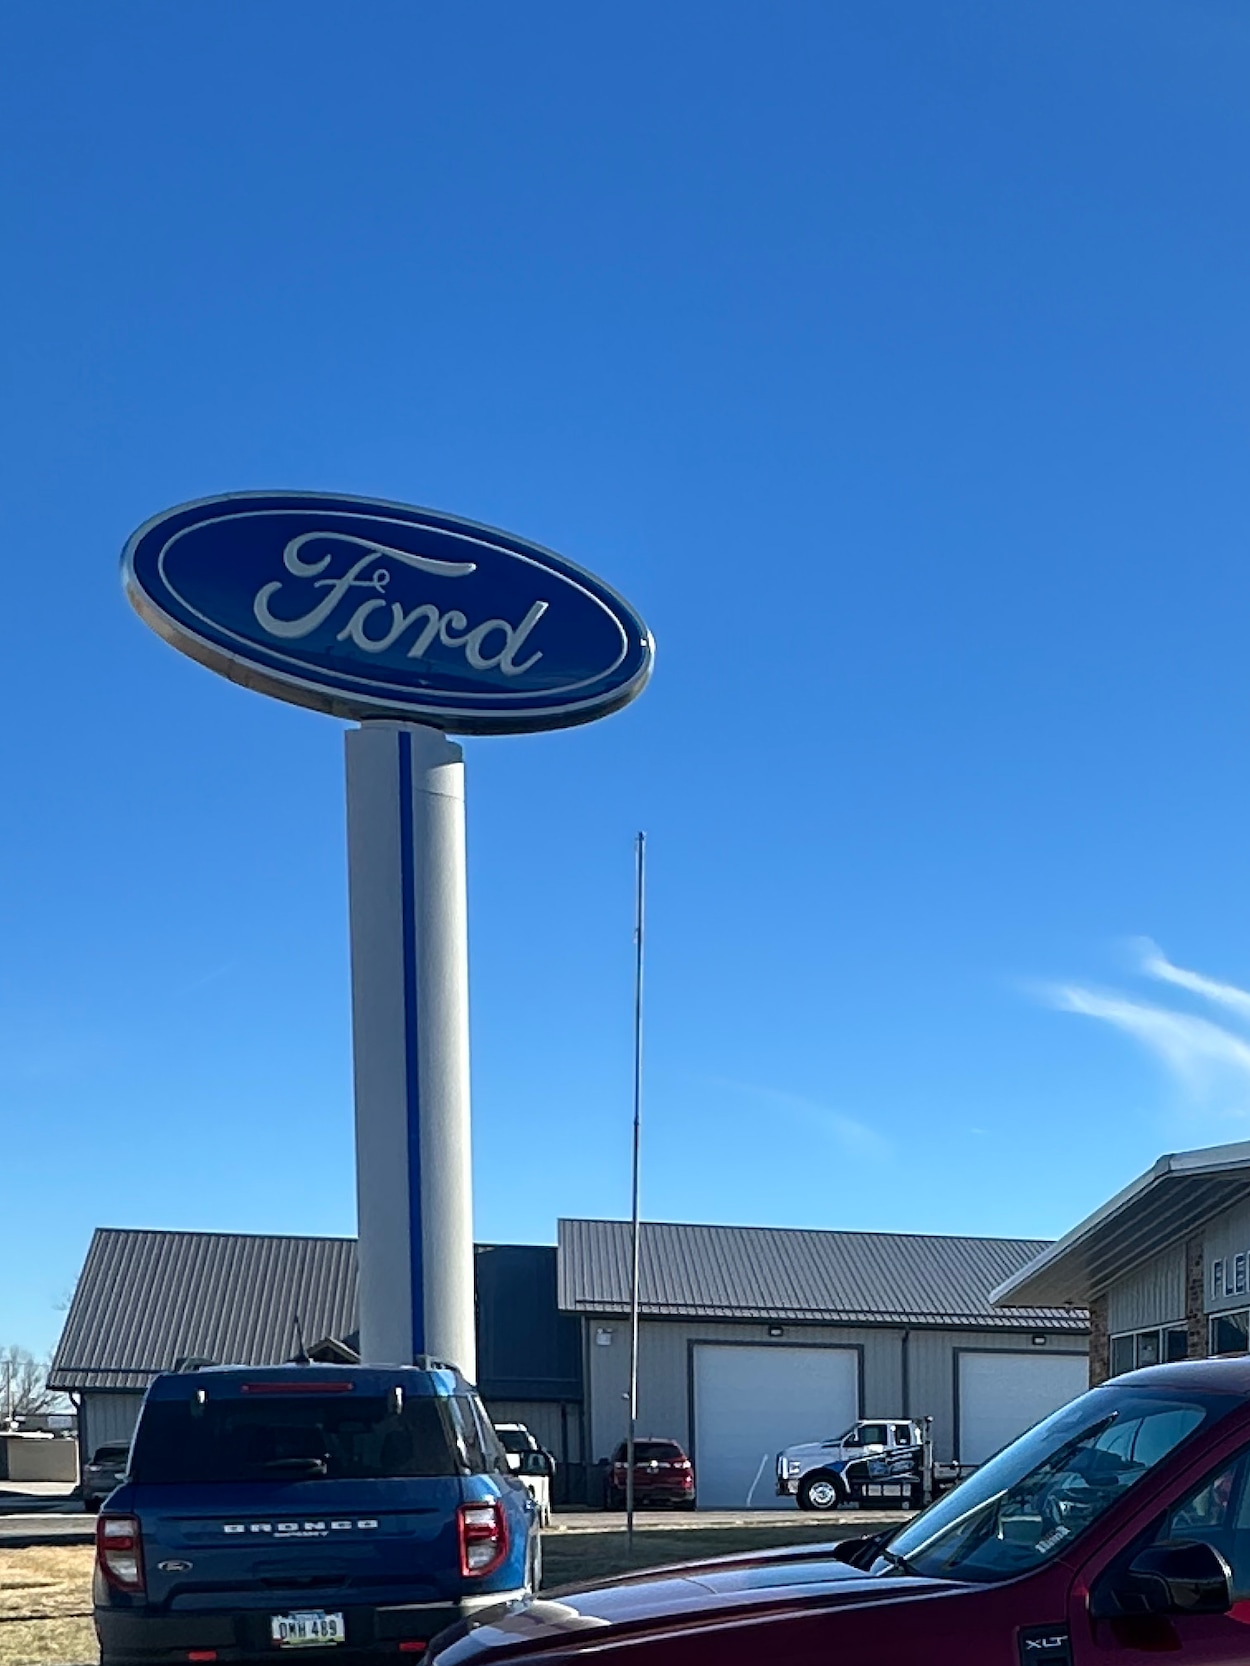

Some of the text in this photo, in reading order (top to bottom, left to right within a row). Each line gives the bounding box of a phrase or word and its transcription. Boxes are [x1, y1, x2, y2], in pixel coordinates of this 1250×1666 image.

[254, 531, 548, 676] Ford
[223, 1519, 379, 1533] BRONCO
[1025, 1635, 1069, 1650] XLT
